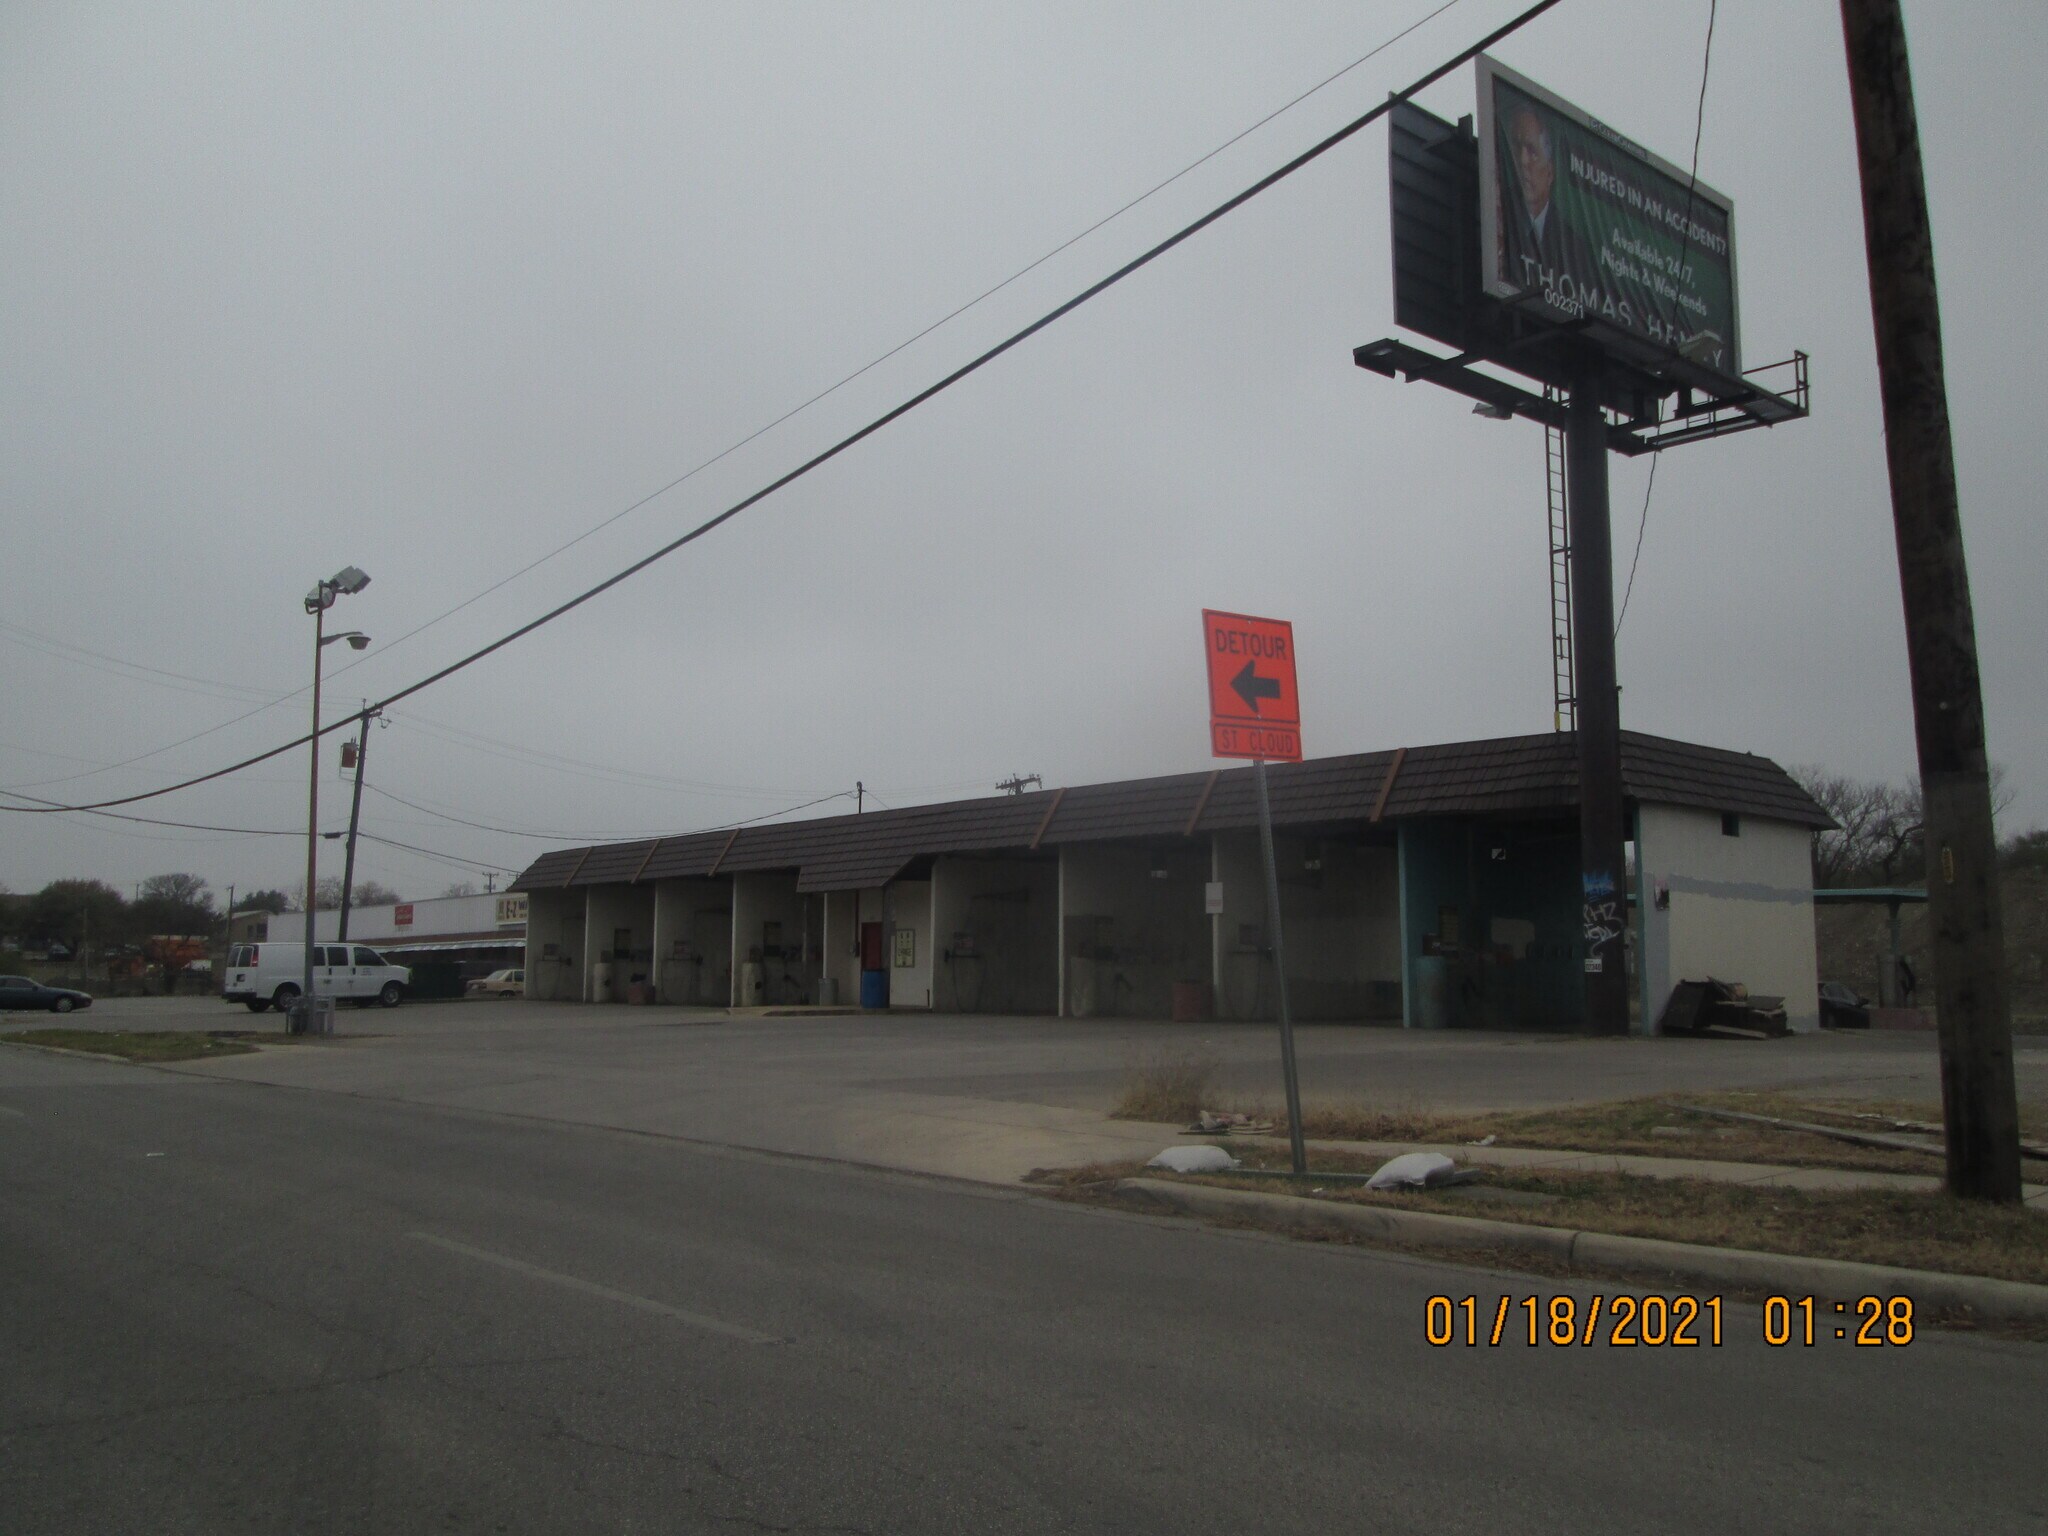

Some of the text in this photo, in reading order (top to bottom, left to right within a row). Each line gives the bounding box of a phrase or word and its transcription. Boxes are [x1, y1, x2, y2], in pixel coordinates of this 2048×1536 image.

[1570, 153, 1726, 257] INJURED IN AN ACCIDENT?
[1601, 245, 1640, 283] Nights
[1642, 267, 1651, 288] &
[1612, 227, 1664, 271] Available
[1520, 253, 1632, 326] THOMAS
[1214, 628, 1287, 661] DETOUR
[1221, 729, 1294, 753] ST CLOUD
